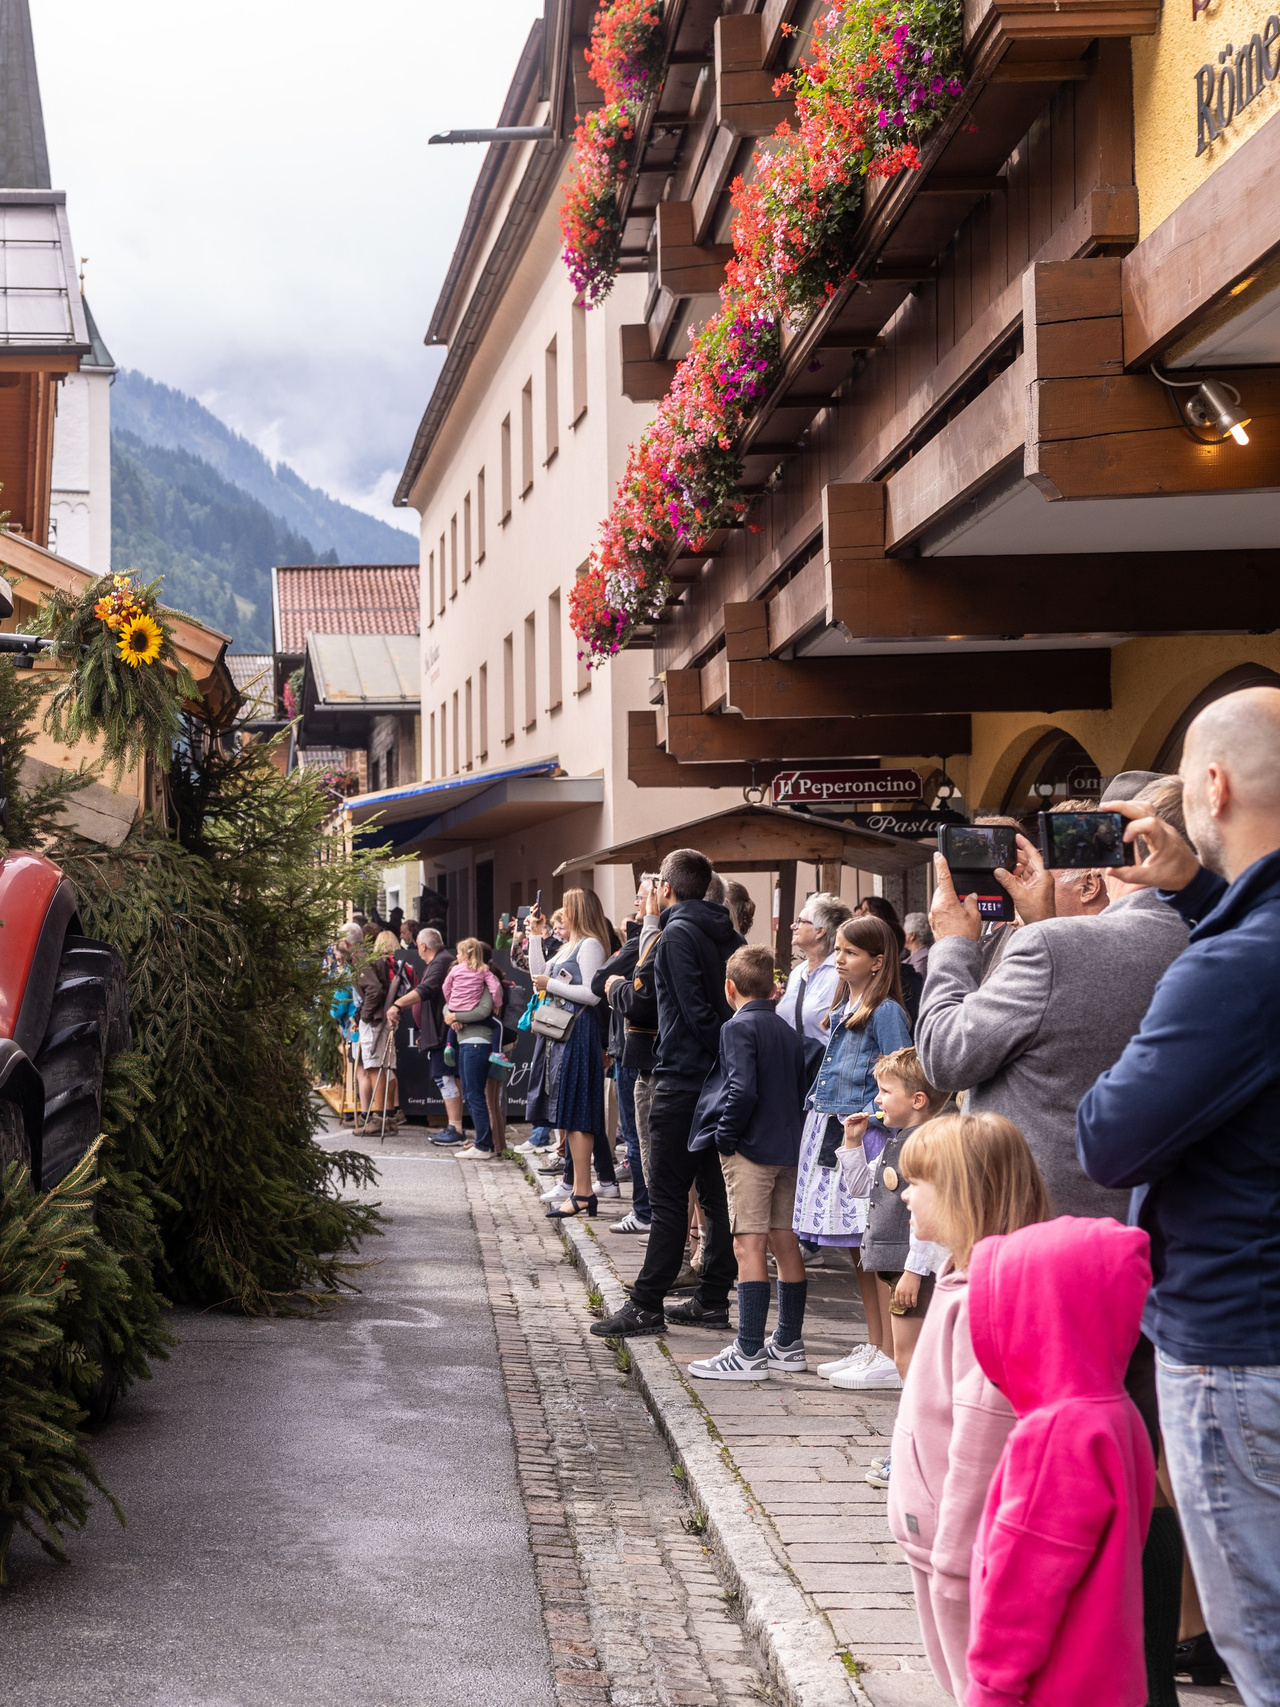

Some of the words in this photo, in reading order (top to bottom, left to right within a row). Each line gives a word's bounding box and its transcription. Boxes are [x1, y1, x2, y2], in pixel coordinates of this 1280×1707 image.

[778, 779, 793, 795] Il
[798, 776, 917, 799] Peperoncino
[866, 815, 942, 833] Pasta
[978, 902, 996, 911] IZEI
[508, 1097, 528, 1105] Dorfga
